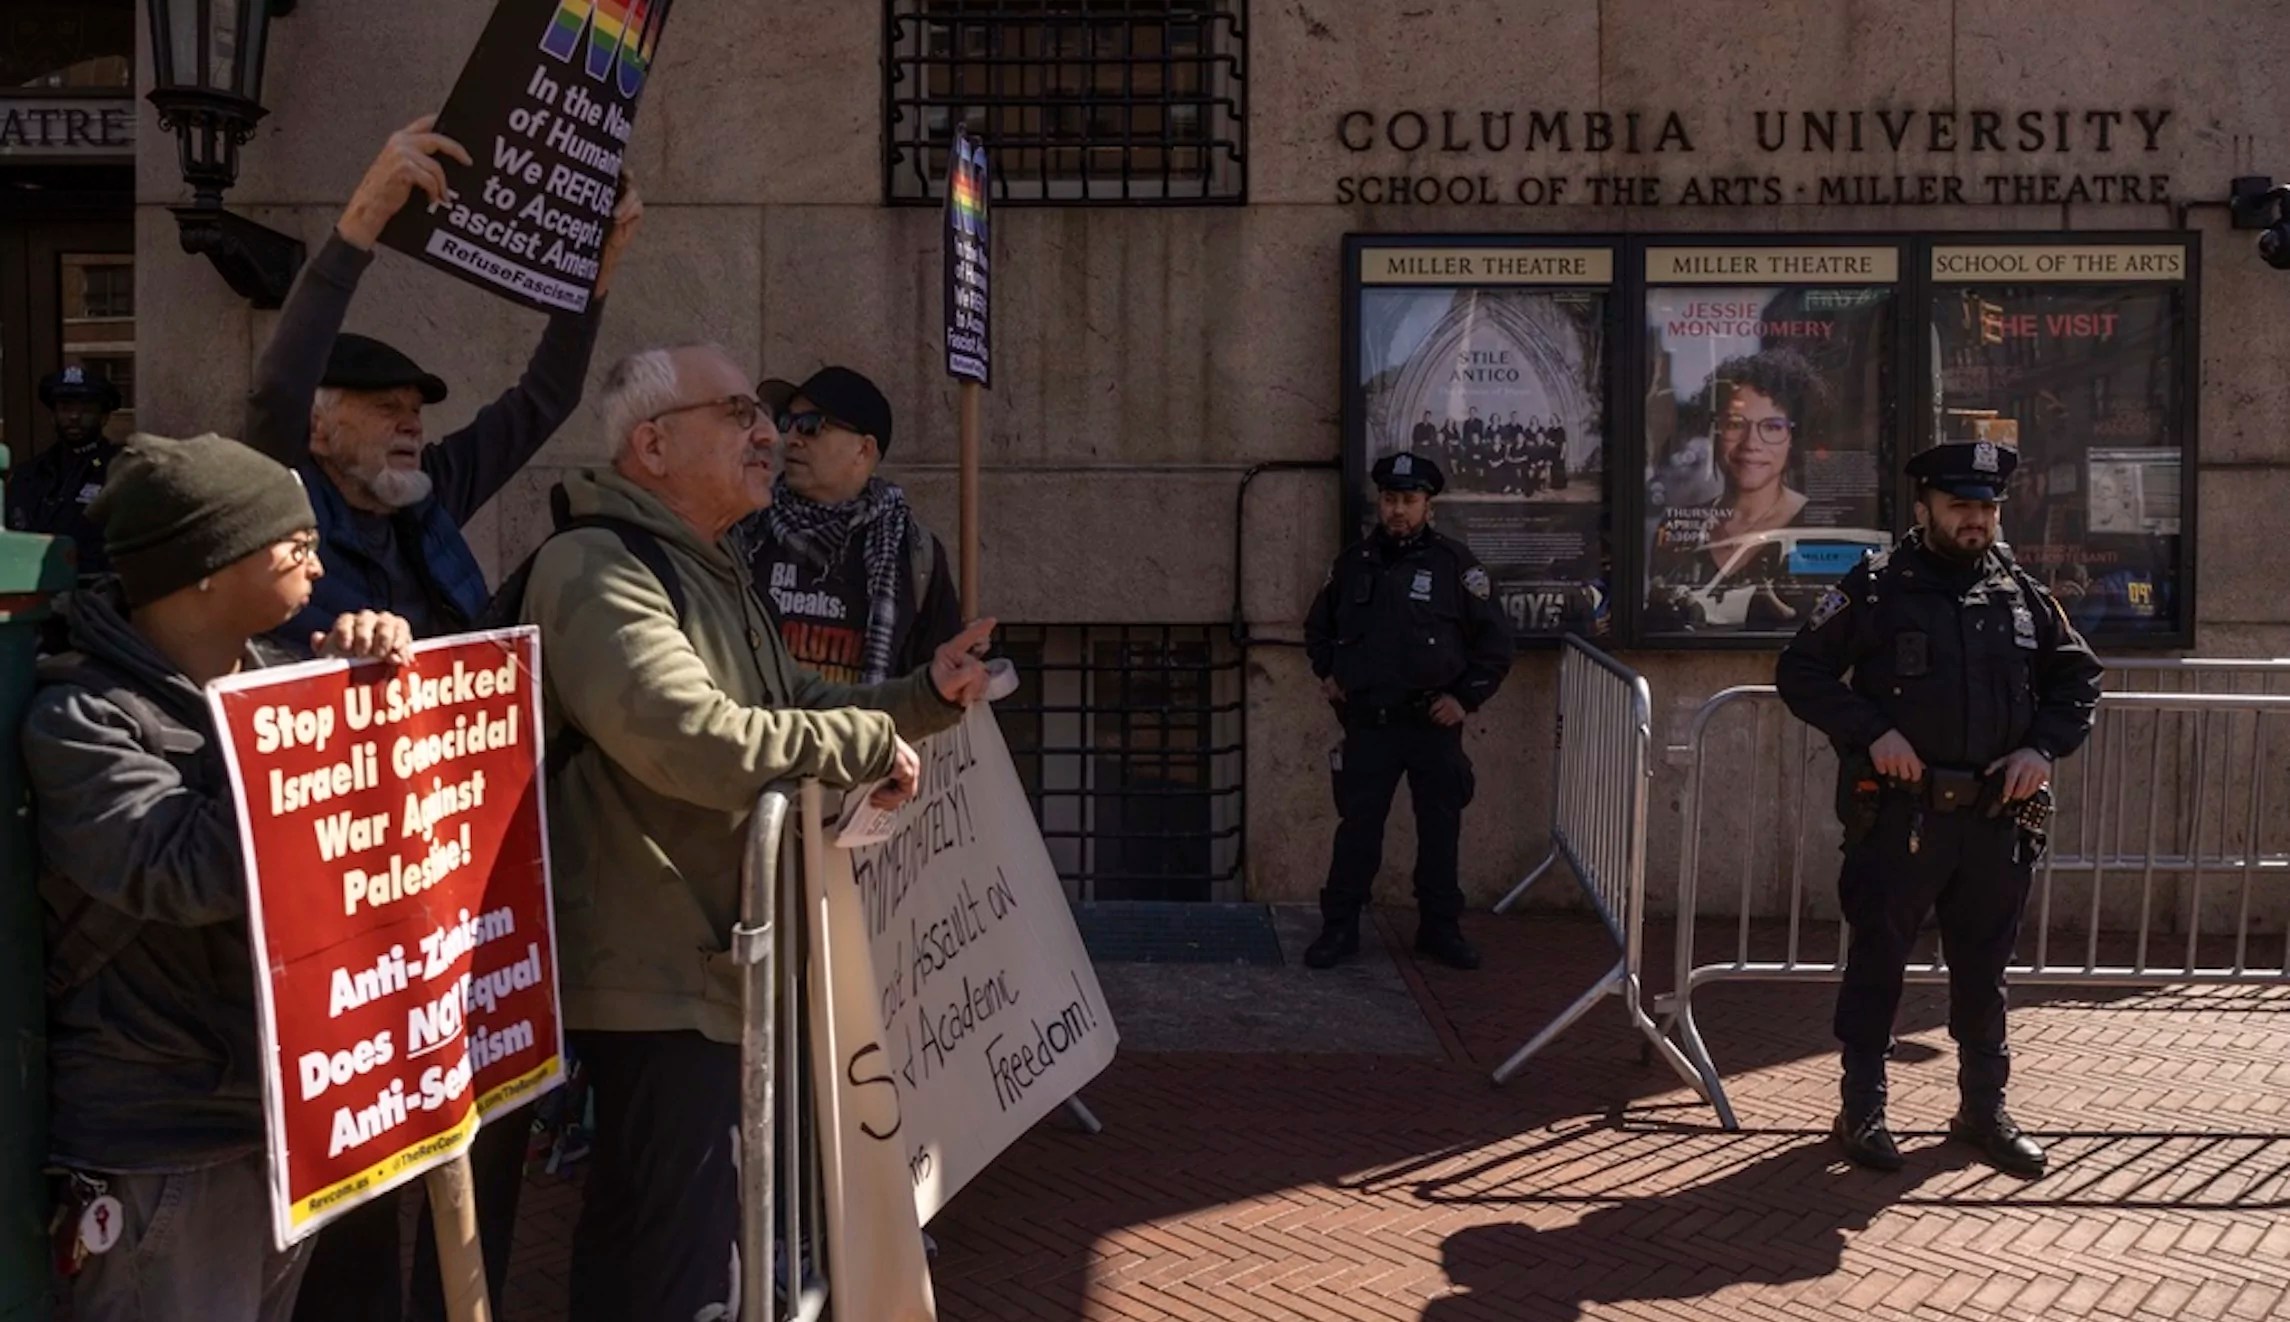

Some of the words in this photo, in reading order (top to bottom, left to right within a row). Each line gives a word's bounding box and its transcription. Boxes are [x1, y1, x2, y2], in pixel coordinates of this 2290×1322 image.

[526, 65, 559, 104] In
[562, 84, 603, 127] the
[509, 107, 550, 139] of
[1337, 110, 1696, 154] COLUMBIA
[1753, 110, 2172, 153] UNIVERSITY
[493, 135, 543, 185] We
[546, 163, 617, 218] REFUS
[1336, 176, 1499, 206] SCHOOL
[1516, 176, 1567, 206] OF
[1586, 176, 1661, 206] THE
[1678, 176, 1782, 206] ARTS
[1817, 175, 1966, 205] MILLER
[1985, 174, 2172, 205] THEATRE
[482, 174, 517, 211] to
[518, 193, 600, 251] Accept
[1386, 256, 1474, 276] MILLER
[1483, 256, 1586, 276] THEATRE
[1672, 256, 1758, 275] MILLER
[1768, 256, 1872, 274] THEATRE
[1936, 254, 2029, 273] SCHOOL
[2036, 254, 2066, 273] OF
[2073, 254, 2117, 273] THE
[2125, 254, 2180, 273] ARTS
[1682, 302, 1758, 319] JESSIE
[2045, 313, 2119, 338] VISIT
[1667, 320, 1836, 339] MONTGOMERY
[1459, 351, 1509, 365] STILE
[1450, 368, 1520, 382] ANTICO
[770, 561, 798, 588] BA
[768, 586, 848, 620] Speaks:
[253, 704, 335, 753] Stop
[269, 741, 379, 816] Israeli
[314, 810, 390, 862] War
[298, 1028, 393, 1102] Does
[308, 1176, 370, 1212] Revcom.us
